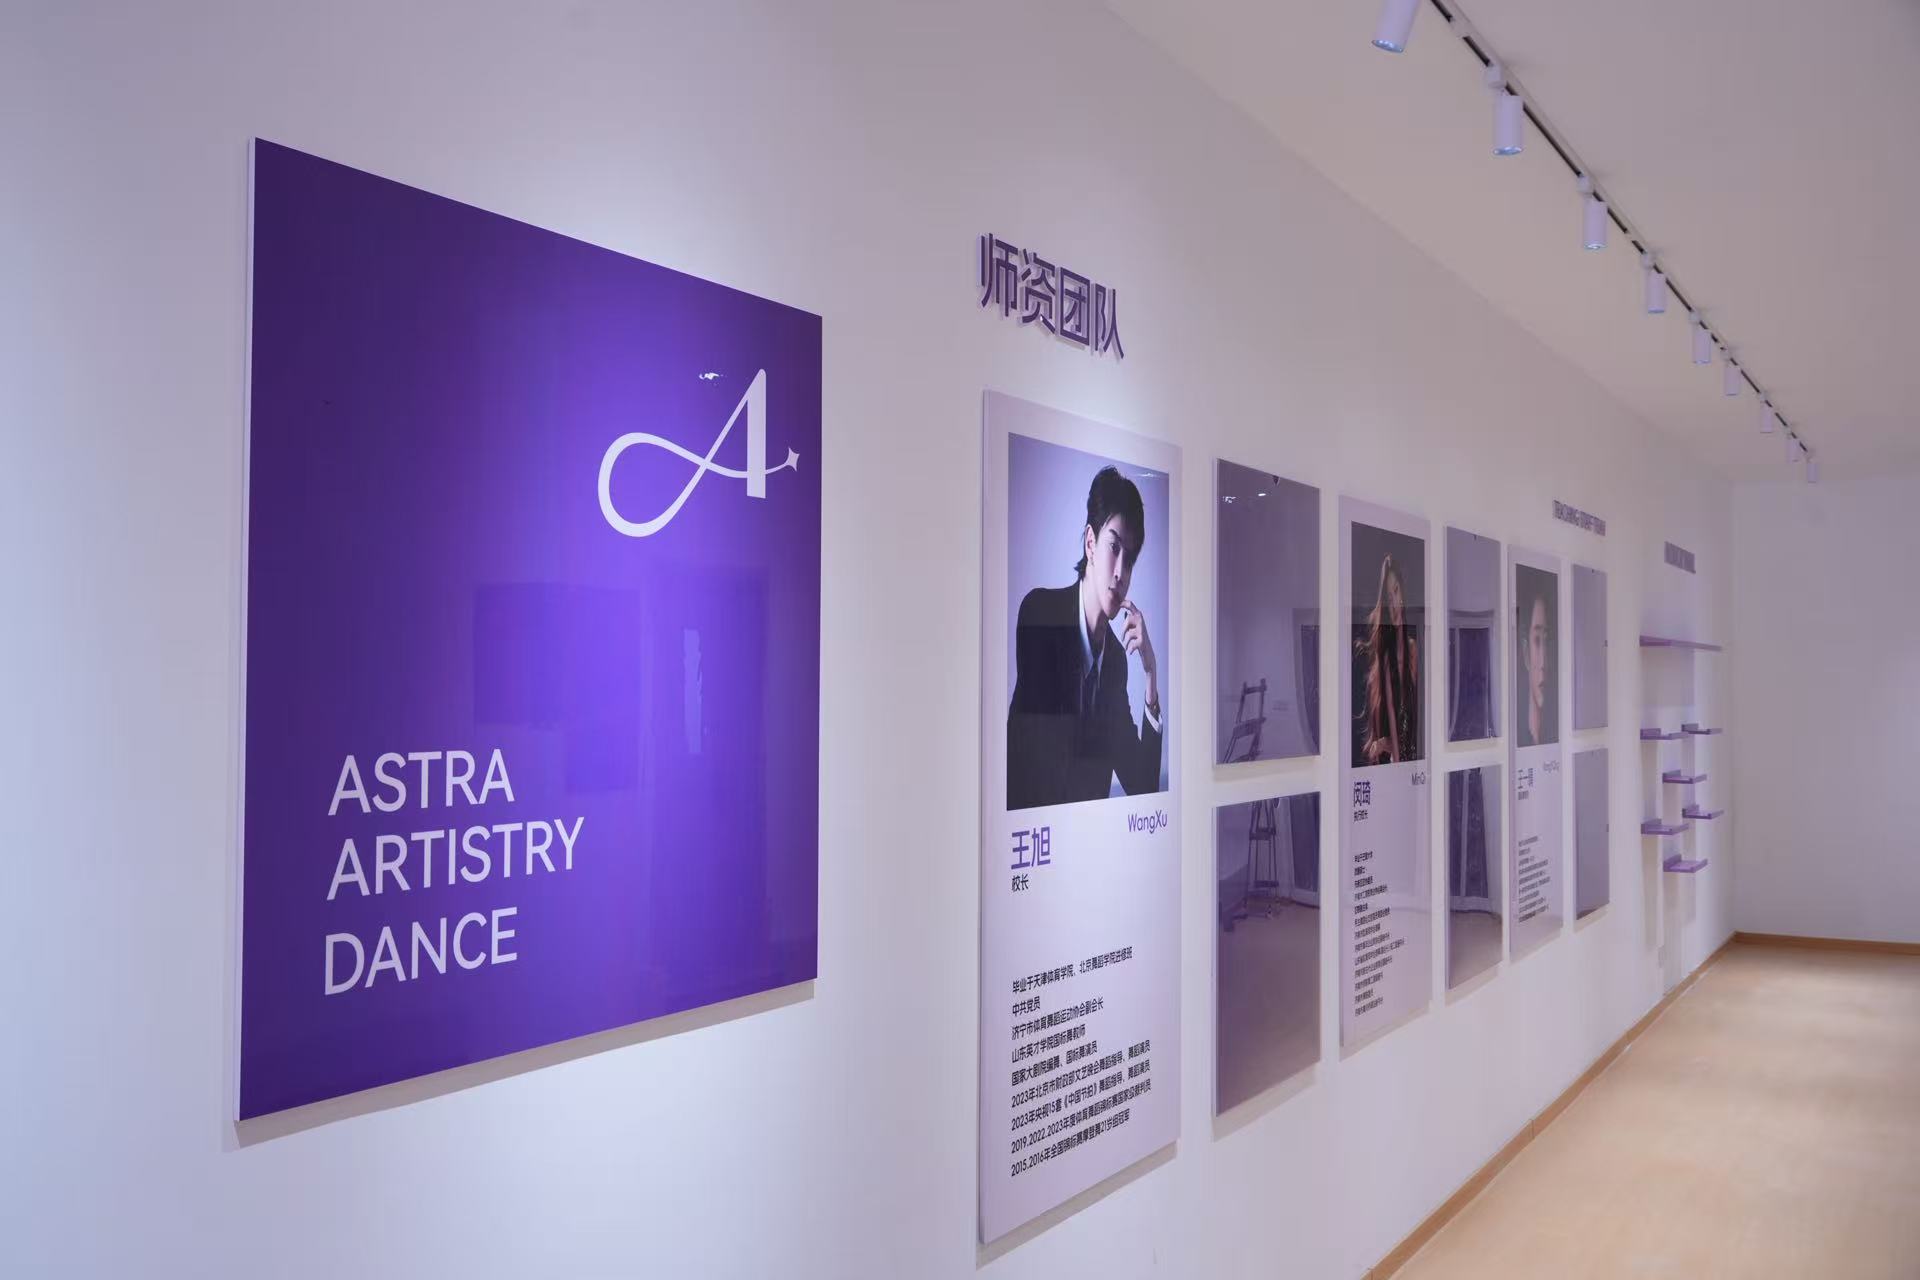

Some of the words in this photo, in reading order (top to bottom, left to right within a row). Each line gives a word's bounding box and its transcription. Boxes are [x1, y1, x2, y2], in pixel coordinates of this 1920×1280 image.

[980, 232, 1125, 359] 师资团队
[328, 749, 515, 816] ASTRA
[1011, 826, 1051, 870] 王旭
[1128, 810, 1168, 834] WangXu
[327, 817, 584, 900] ARTISTRY
[1011, 874, 1029, 892] 校长
[324, 907, 518, 996] DANCE
[1012, 996, 1041, 1017] 中共党员
